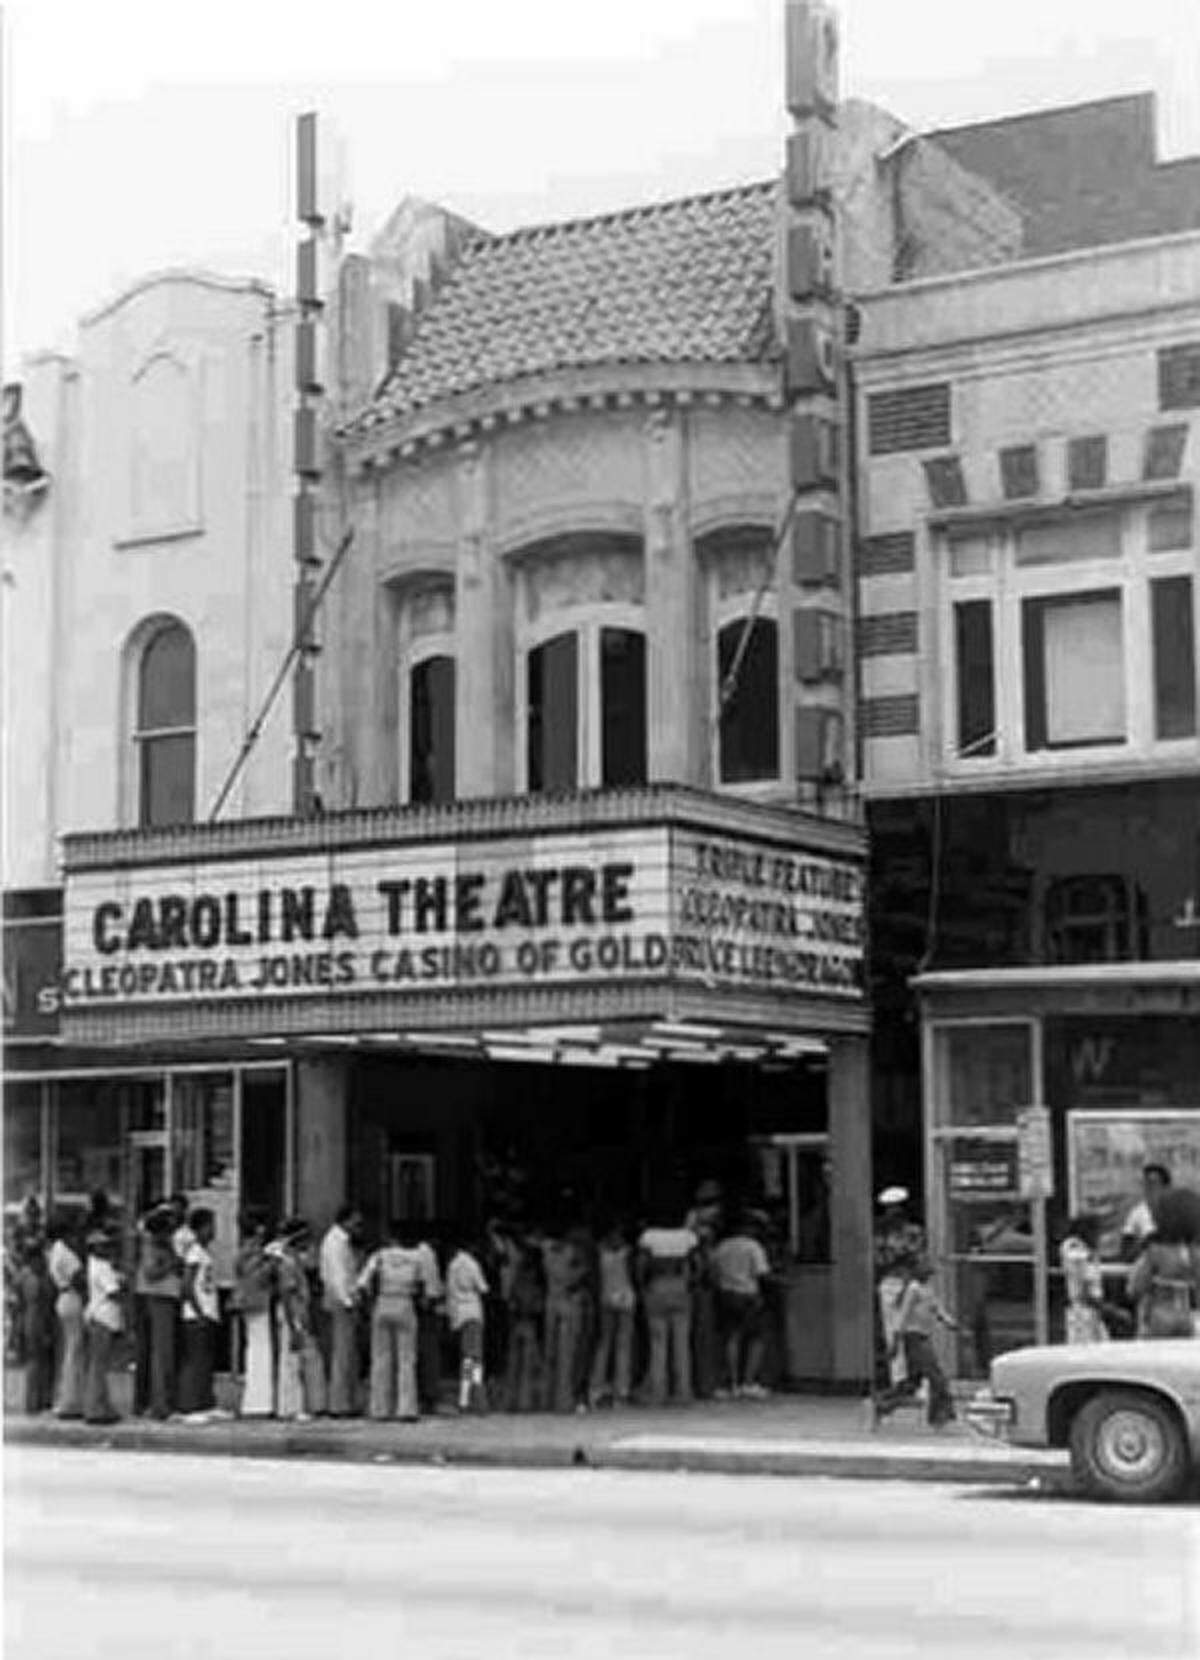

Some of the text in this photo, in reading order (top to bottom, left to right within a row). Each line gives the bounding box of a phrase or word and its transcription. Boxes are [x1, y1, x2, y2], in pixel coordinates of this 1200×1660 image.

[93, 862, 634, 955] CAROLINA THEATRE
[63, 957, 244, 998] CLEOPATRA
[250, 950, 357, 991] JONES
[370, 943, 501, 983] CASINO
[516, 940, 561, 976] OF
[569, 935, 667, 973] GOLD
